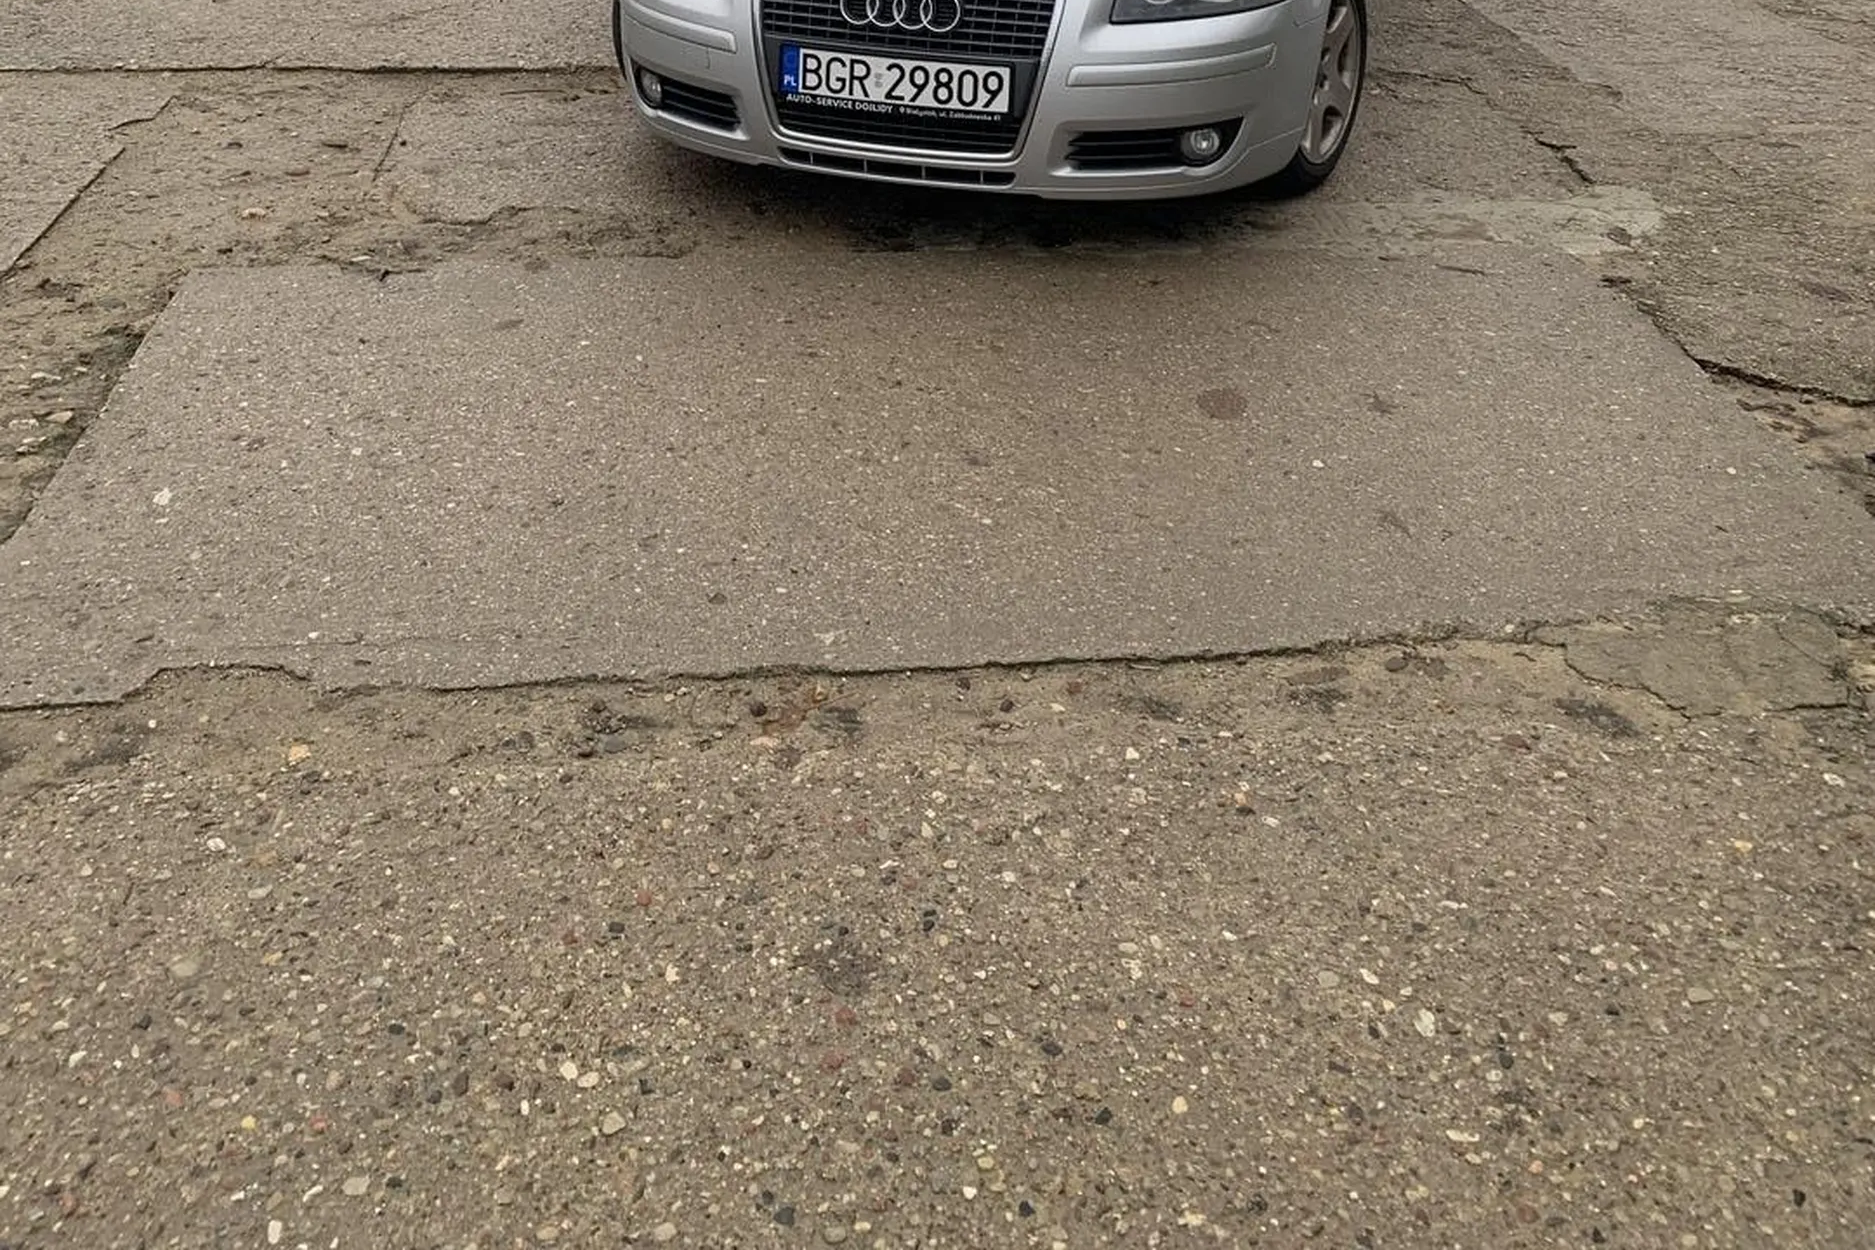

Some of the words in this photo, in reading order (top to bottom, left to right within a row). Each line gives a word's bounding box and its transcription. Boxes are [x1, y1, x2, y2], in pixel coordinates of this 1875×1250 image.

[783, 74, 797, 87] PL
[802, 53, 870, 98] BGR
[885, 62, 1004, 109] 29809
[786, 93, 853, 109] AUTO-SERVICE
